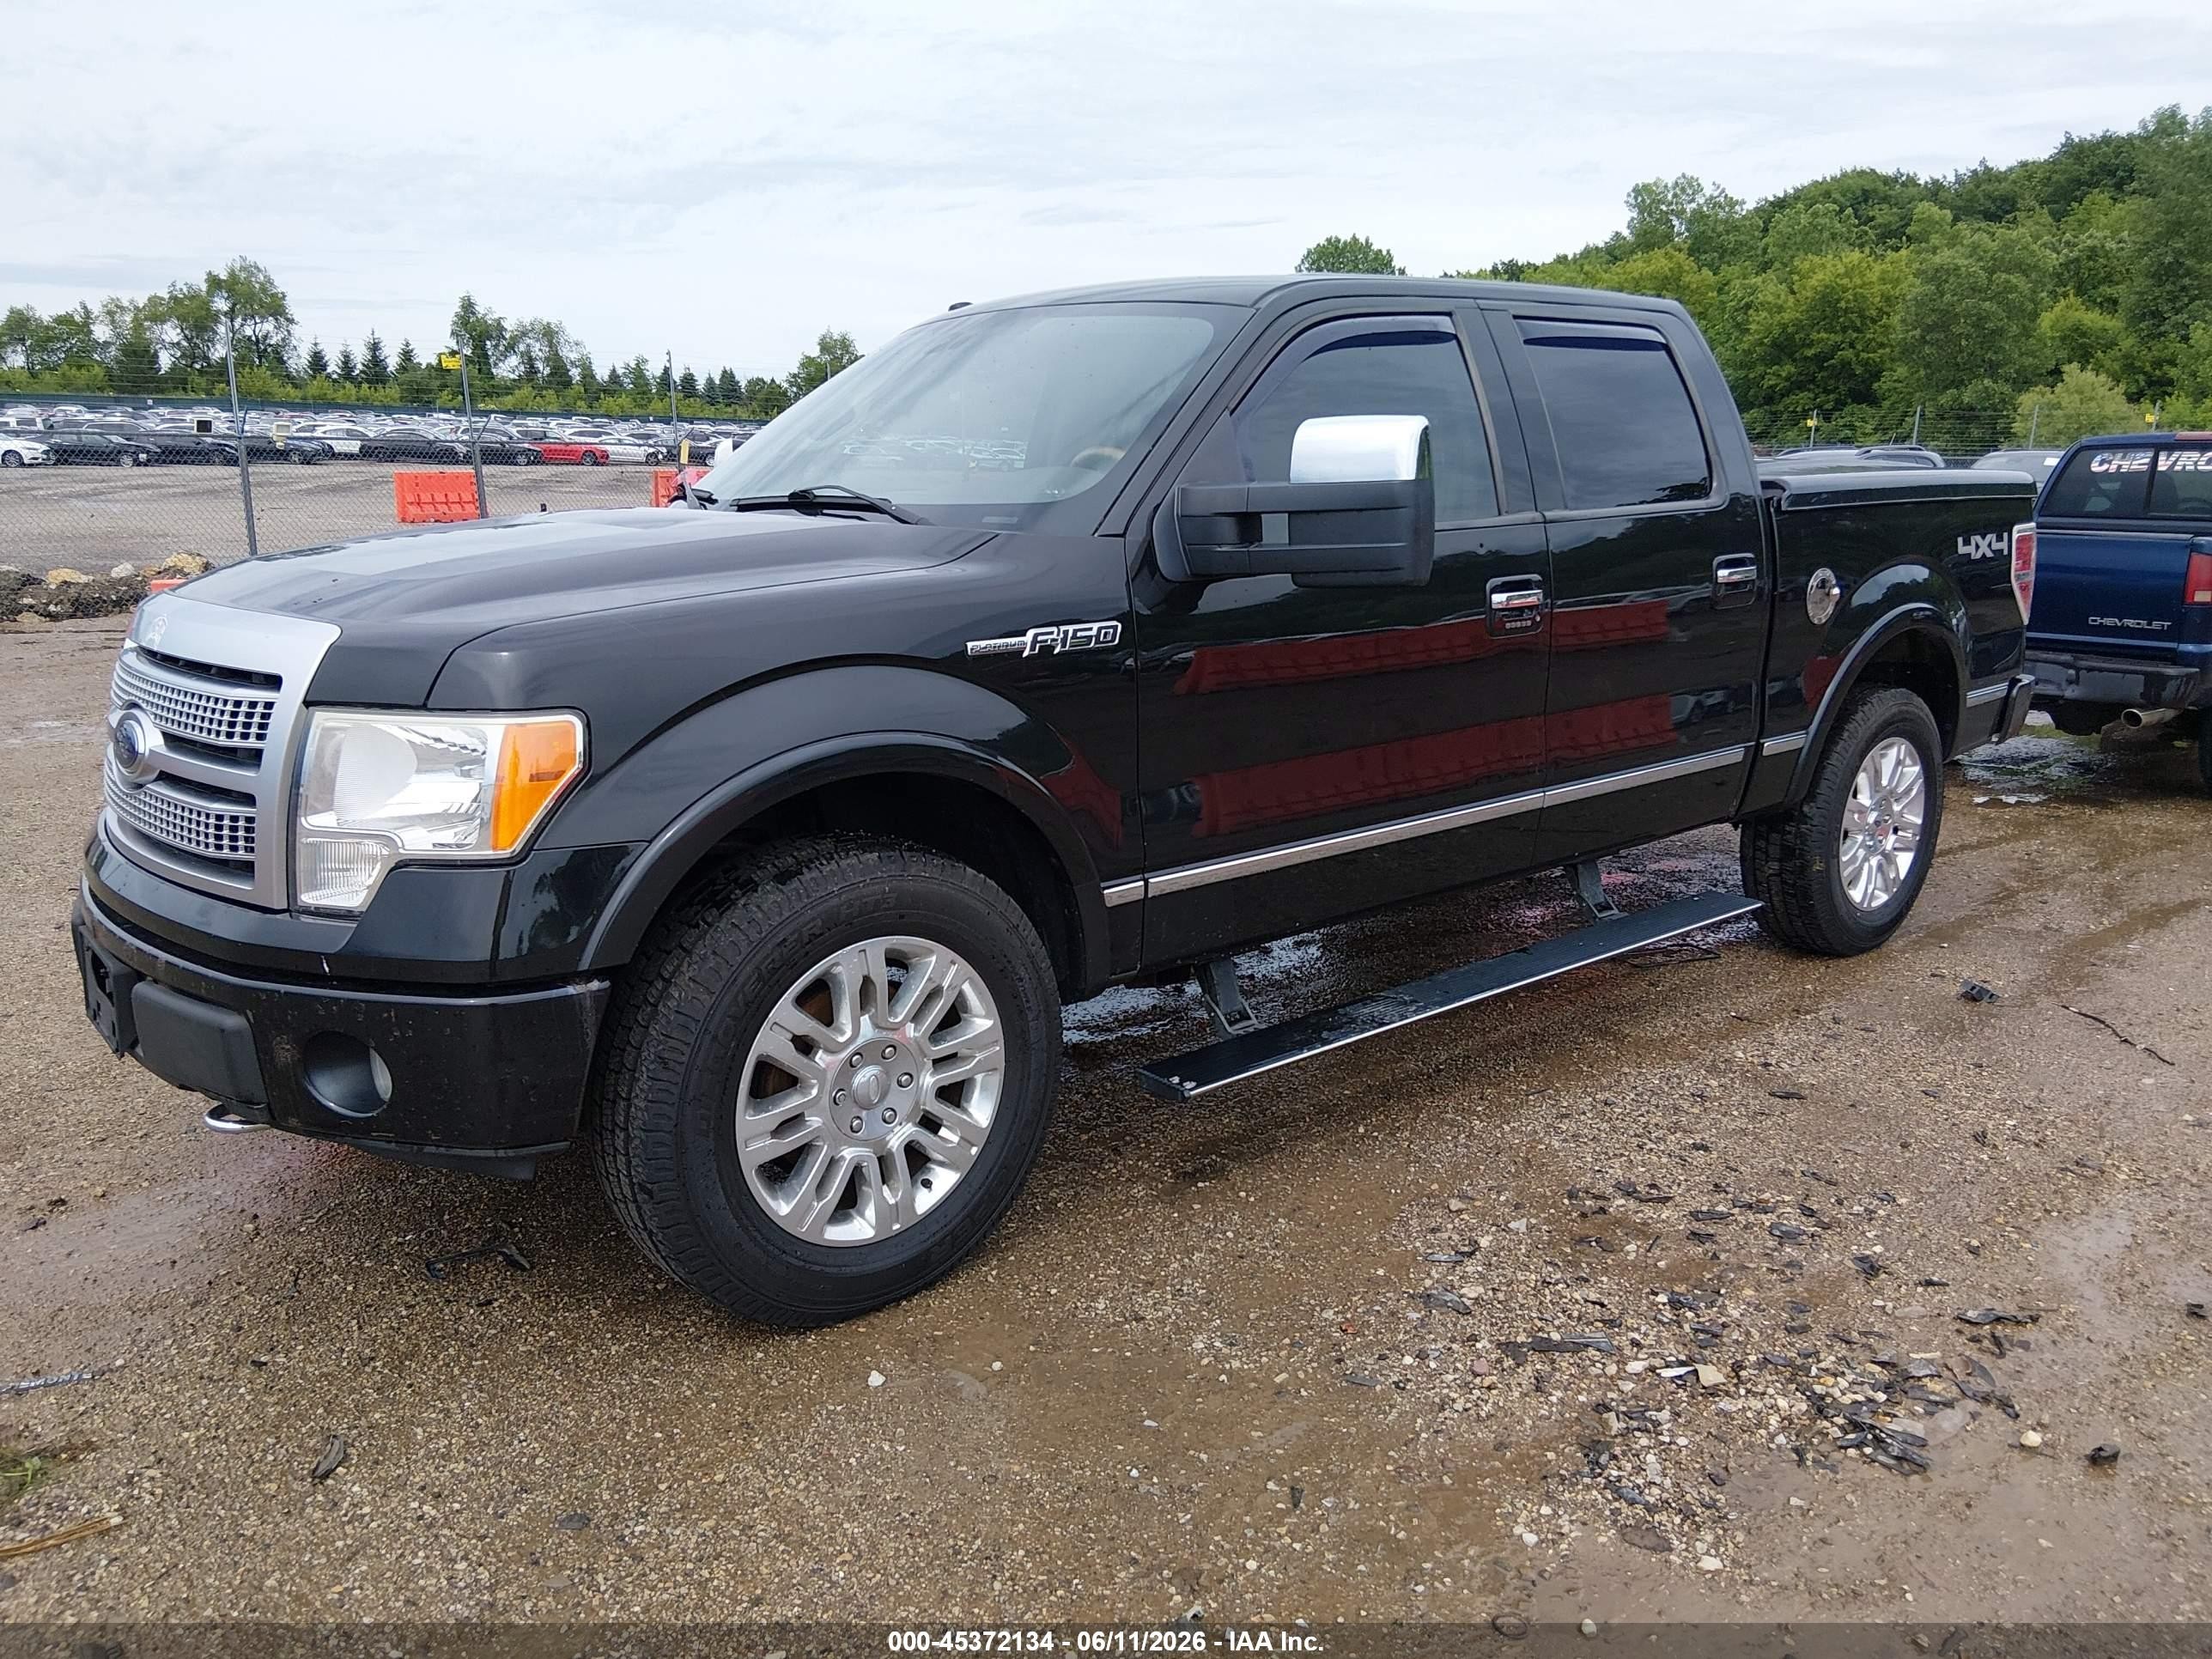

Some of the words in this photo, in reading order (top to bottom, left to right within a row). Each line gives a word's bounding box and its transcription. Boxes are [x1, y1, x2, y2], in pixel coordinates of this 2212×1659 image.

[2087, 617, 2172, 630] CHEVROLET
[969, 640, 1027, 654] PLATINUM
[1027, 623, 1121, 656] F-150
